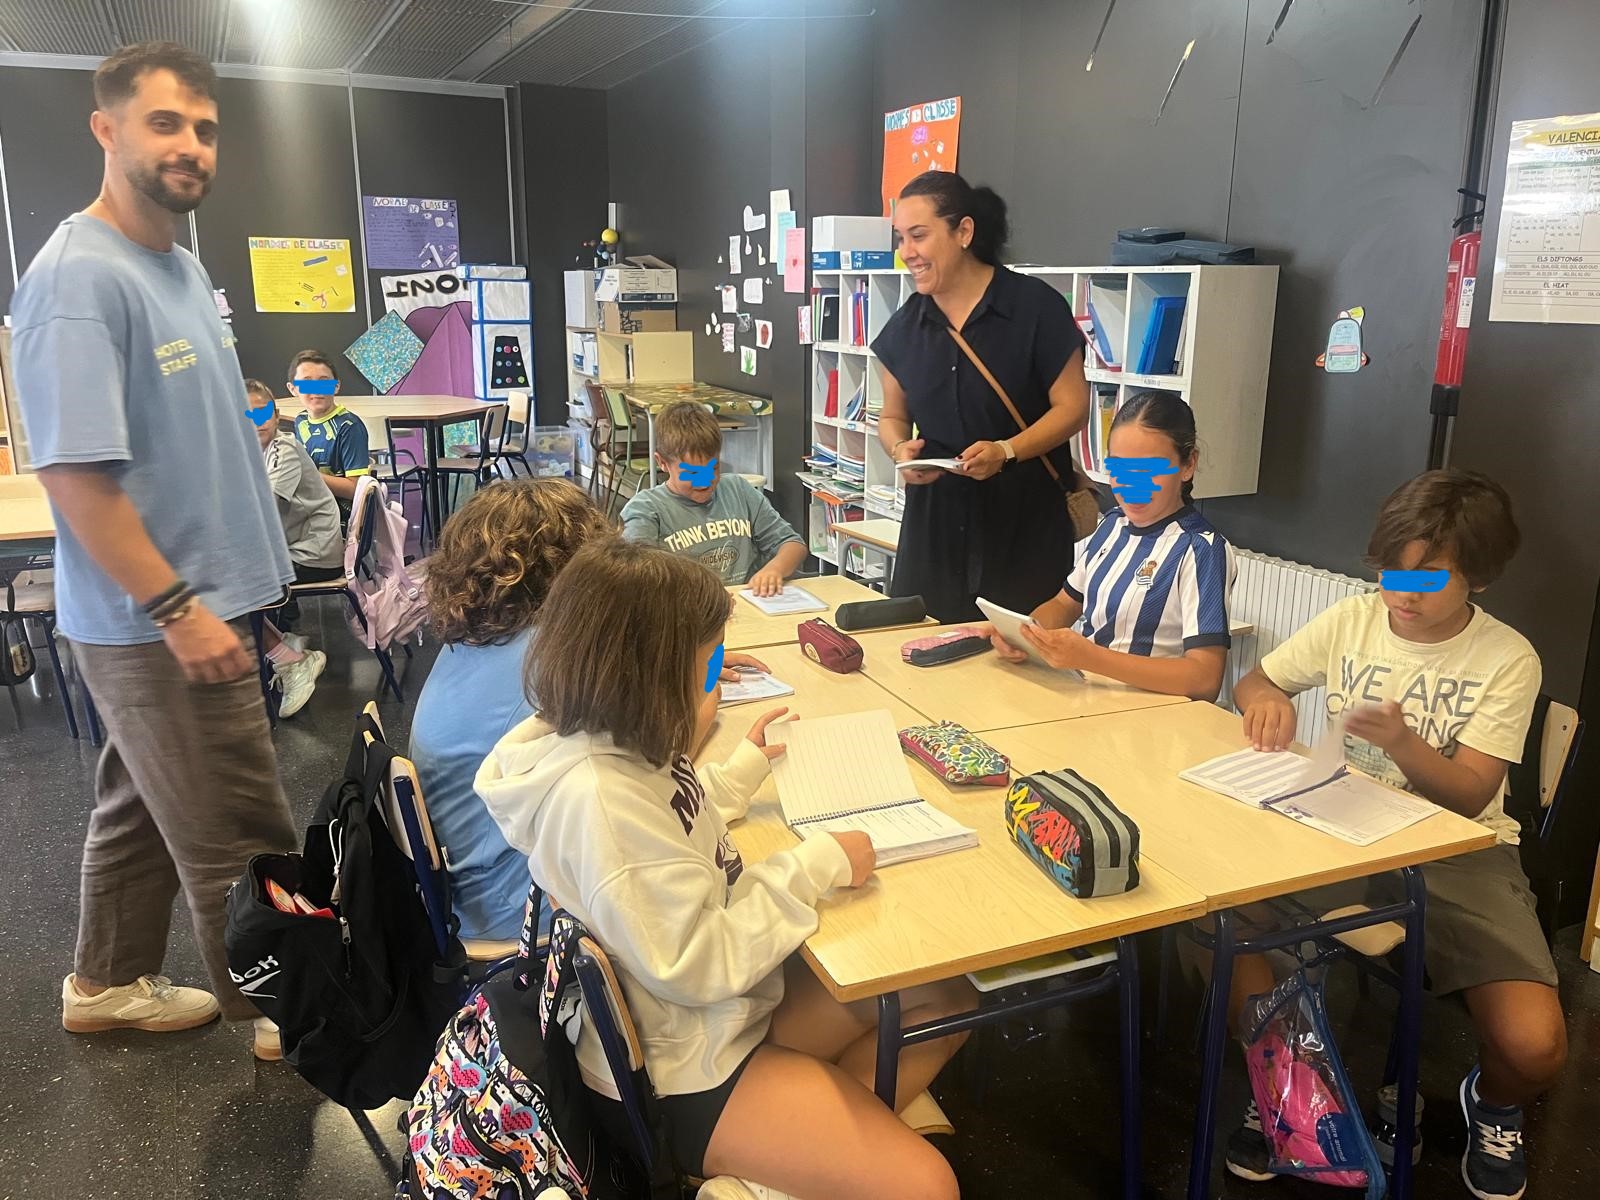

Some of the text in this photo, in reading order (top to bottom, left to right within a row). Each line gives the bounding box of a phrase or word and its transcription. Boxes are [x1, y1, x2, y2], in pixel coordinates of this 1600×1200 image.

[924, 100, 956, 121] CLASSE
[160, 353, 197, 375] STAFF
[664, 524, 707, 552] THINK
[1342, 656, 1482, 717] WE ARE
